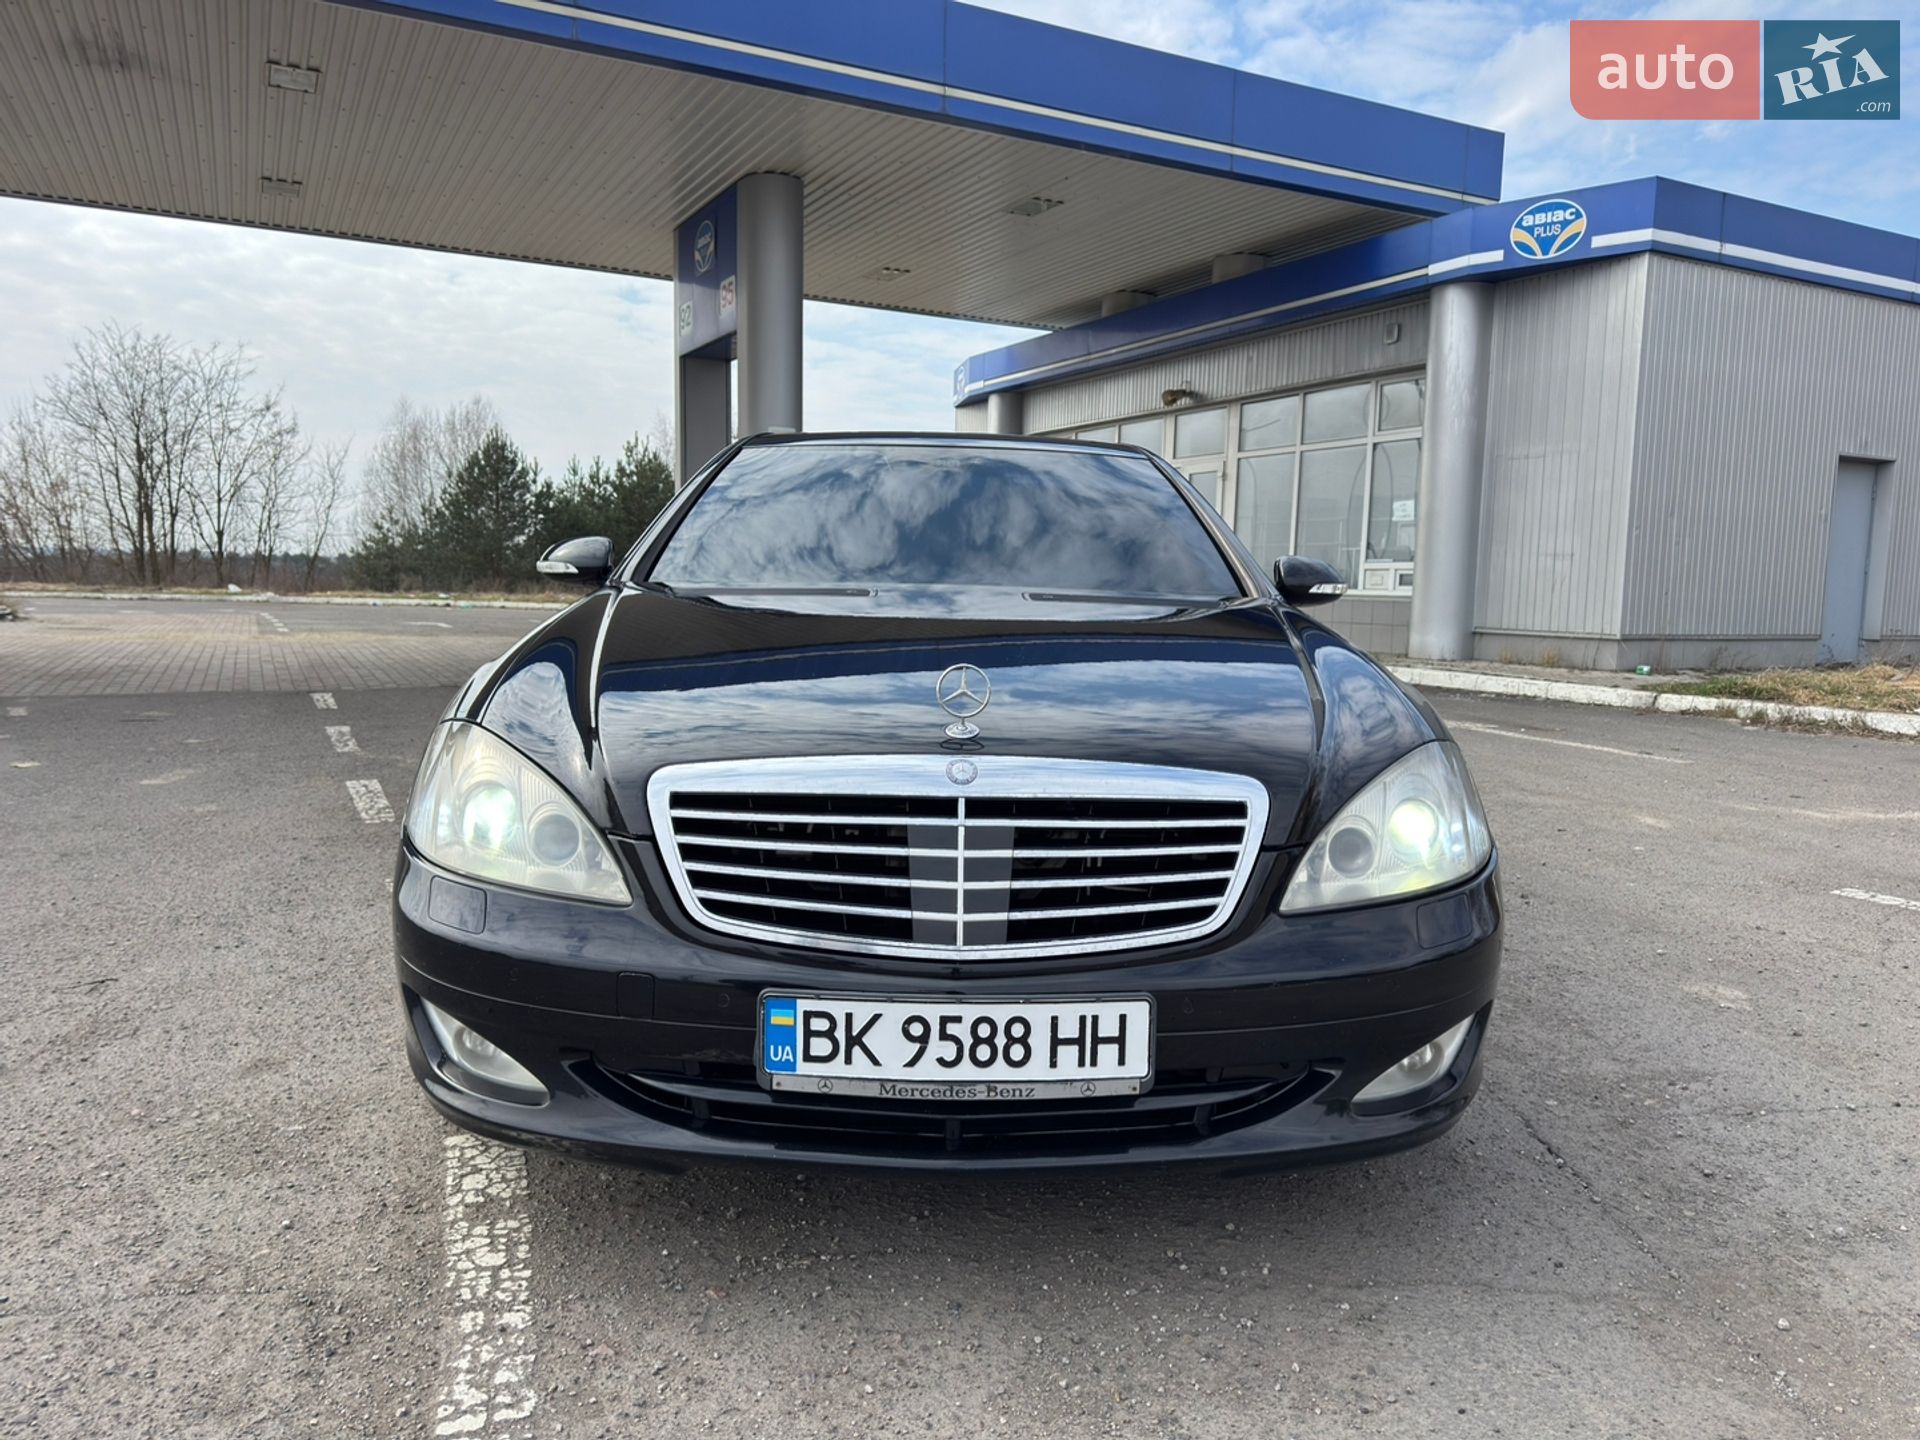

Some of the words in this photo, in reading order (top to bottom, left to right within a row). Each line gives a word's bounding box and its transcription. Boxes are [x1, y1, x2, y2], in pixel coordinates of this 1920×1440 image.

[1533, 224, 1561, 238] PLUS
[802, 1010, 883, 1066] BK
[901, 1015, 1032, 1069] 9588
[1050, 1013, 1127, 1069] HH
[770, 1045, 794, 1063] UA
[879, 1083, 1036, 1099] Mercedes-Benz
